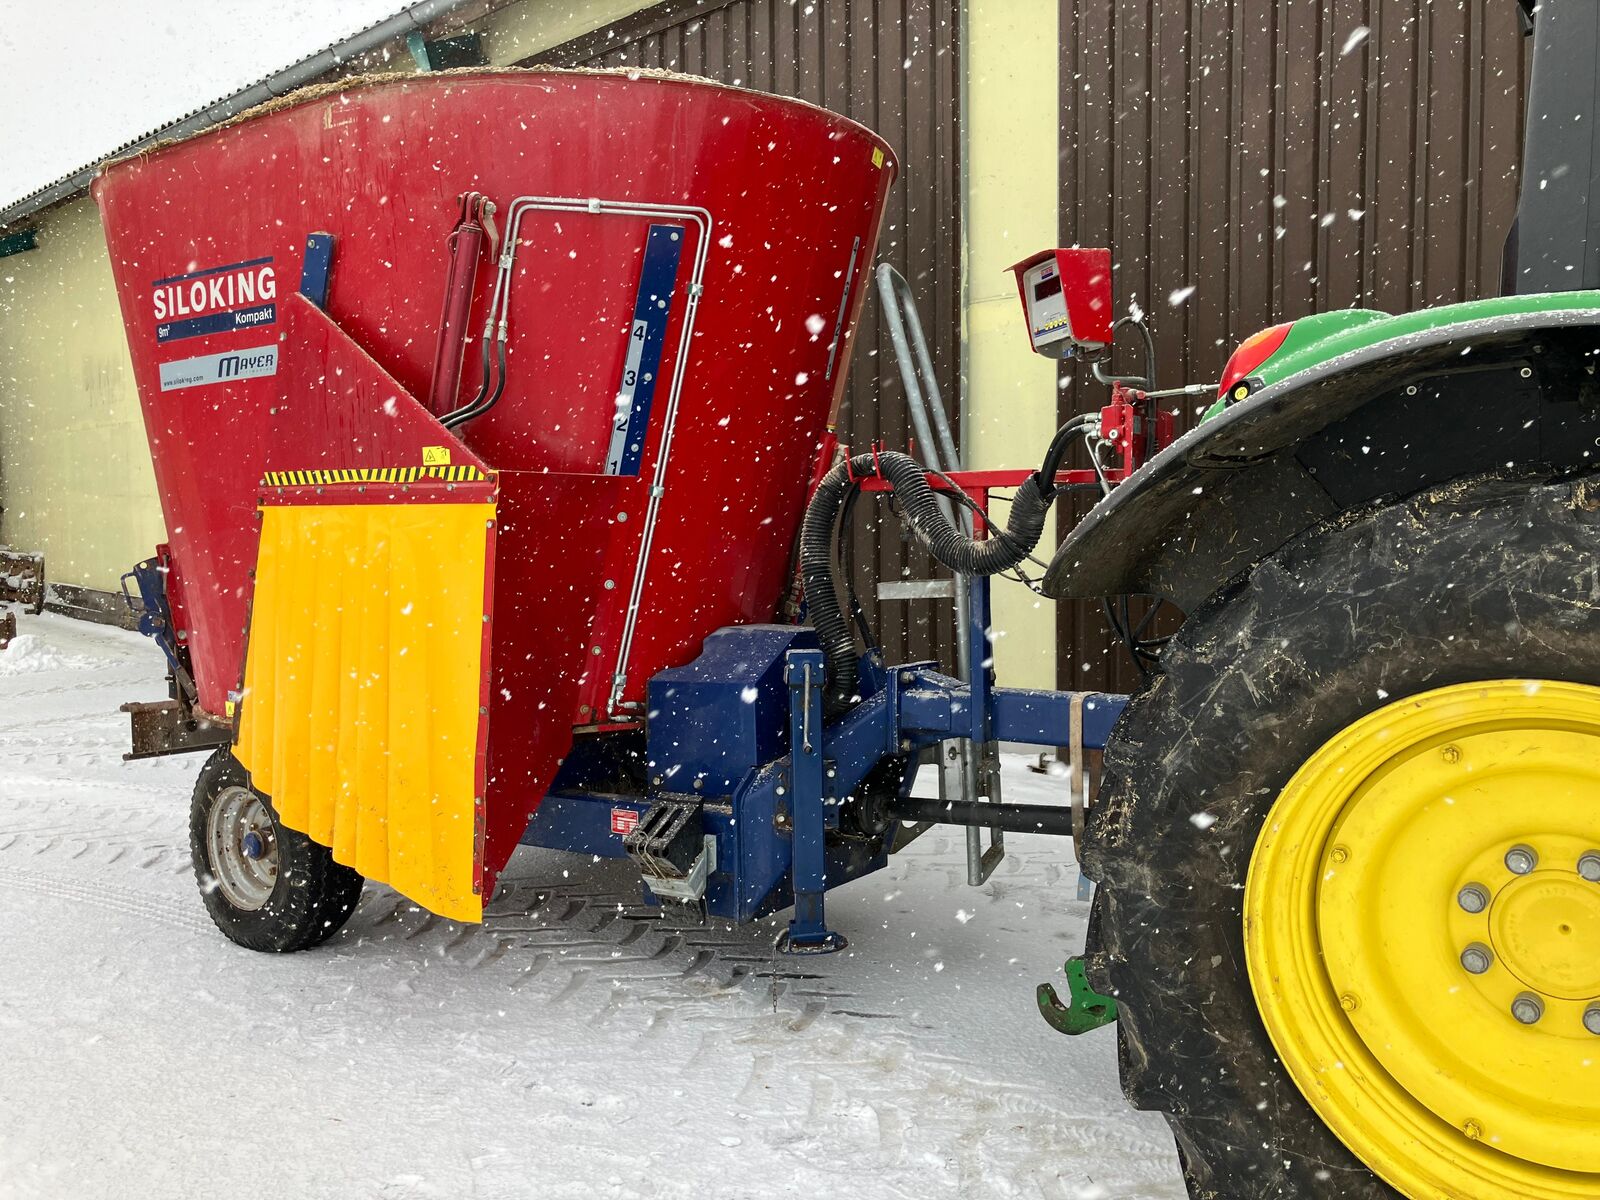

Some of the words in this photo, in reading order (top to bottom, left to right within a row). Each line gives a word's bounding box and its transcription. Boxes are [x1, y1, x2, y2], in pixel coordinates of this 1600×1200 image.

[153, 267, 276, 320] SILOKING
[235, 308, 273, 324] Kompakt
[633, 326, 645, 341] 4
[218, 354, 274, 378] MAYER
[625, 370, 636, 386] 3
[616, 417, 628, 432] 2
[610, 460, 618, 475] 1
